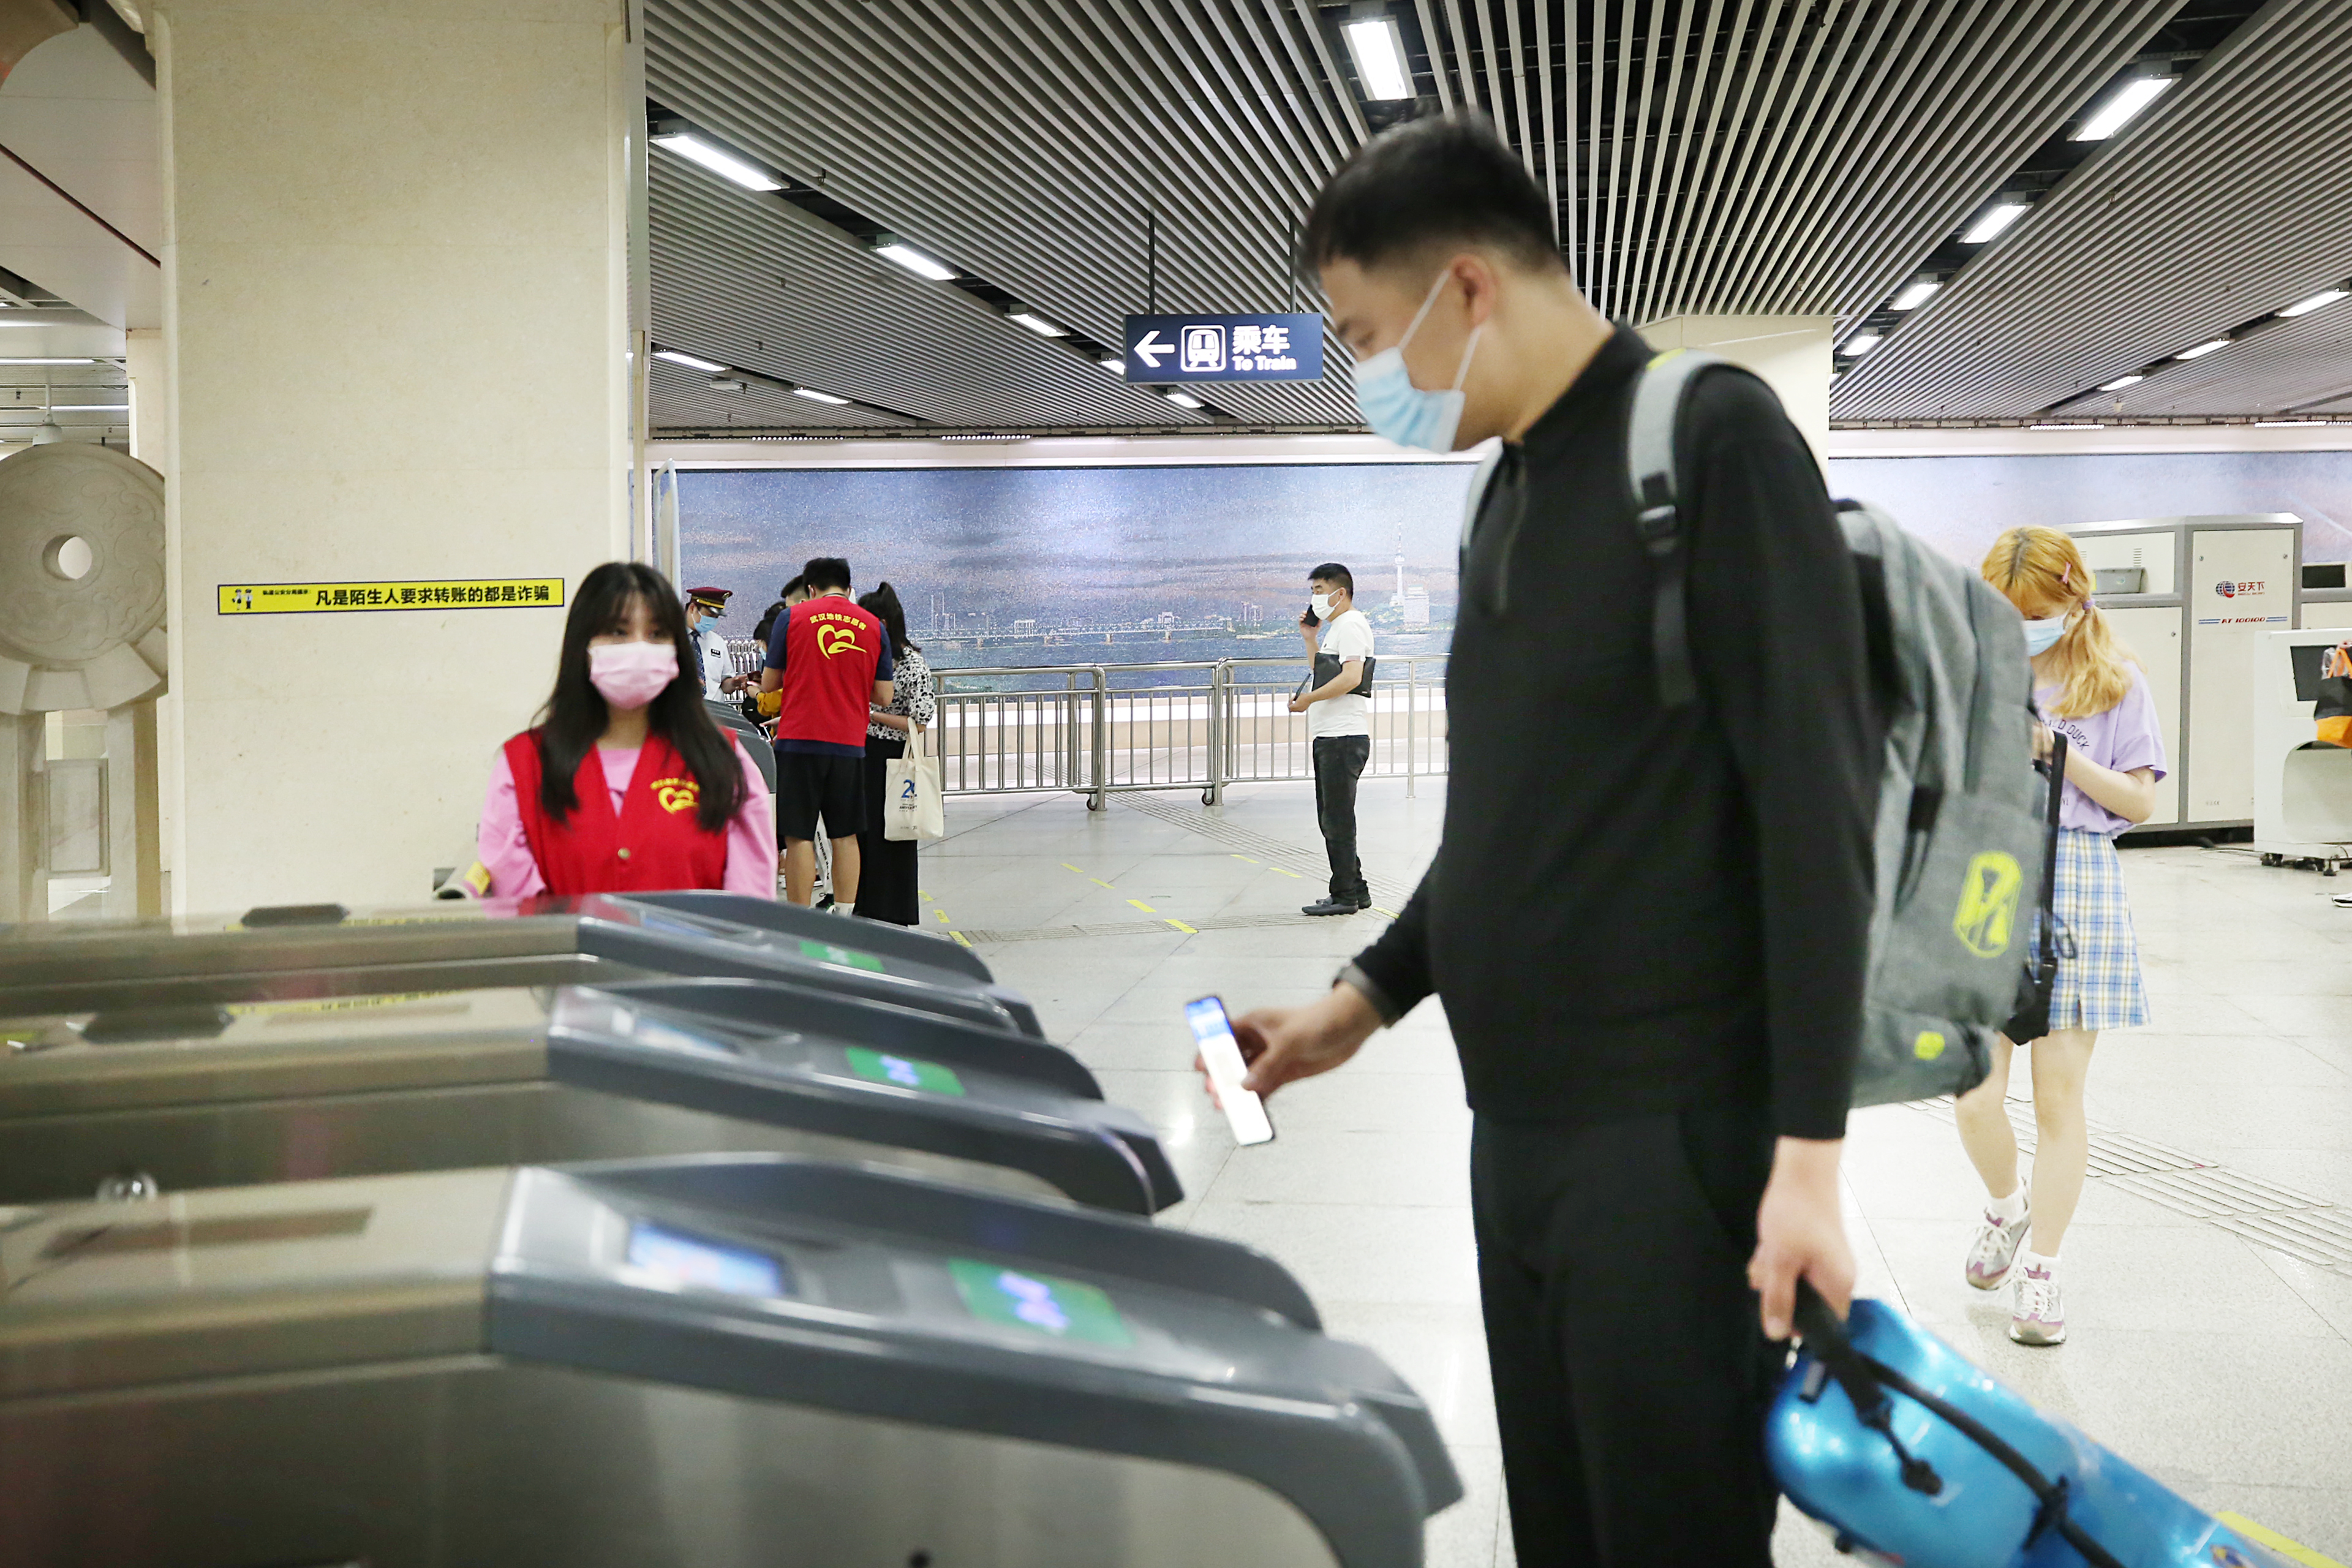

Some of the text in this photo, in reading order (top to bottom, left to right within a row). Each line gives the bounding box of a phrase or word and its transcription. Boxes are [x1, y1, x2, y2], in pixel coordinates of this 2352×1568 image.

[1232, 325, 1291, 355] 乘车
[1232, 355, 1297, 371] To Train
[315, 585, 550, 606] 凡是陌生人要求转账的都是诈骗
[2237, 581, 2265, 592] 安天下
[810, 612, 867, 630] 武汉地铁志愿者
[2067, 725, 2089, 751] DUCK
